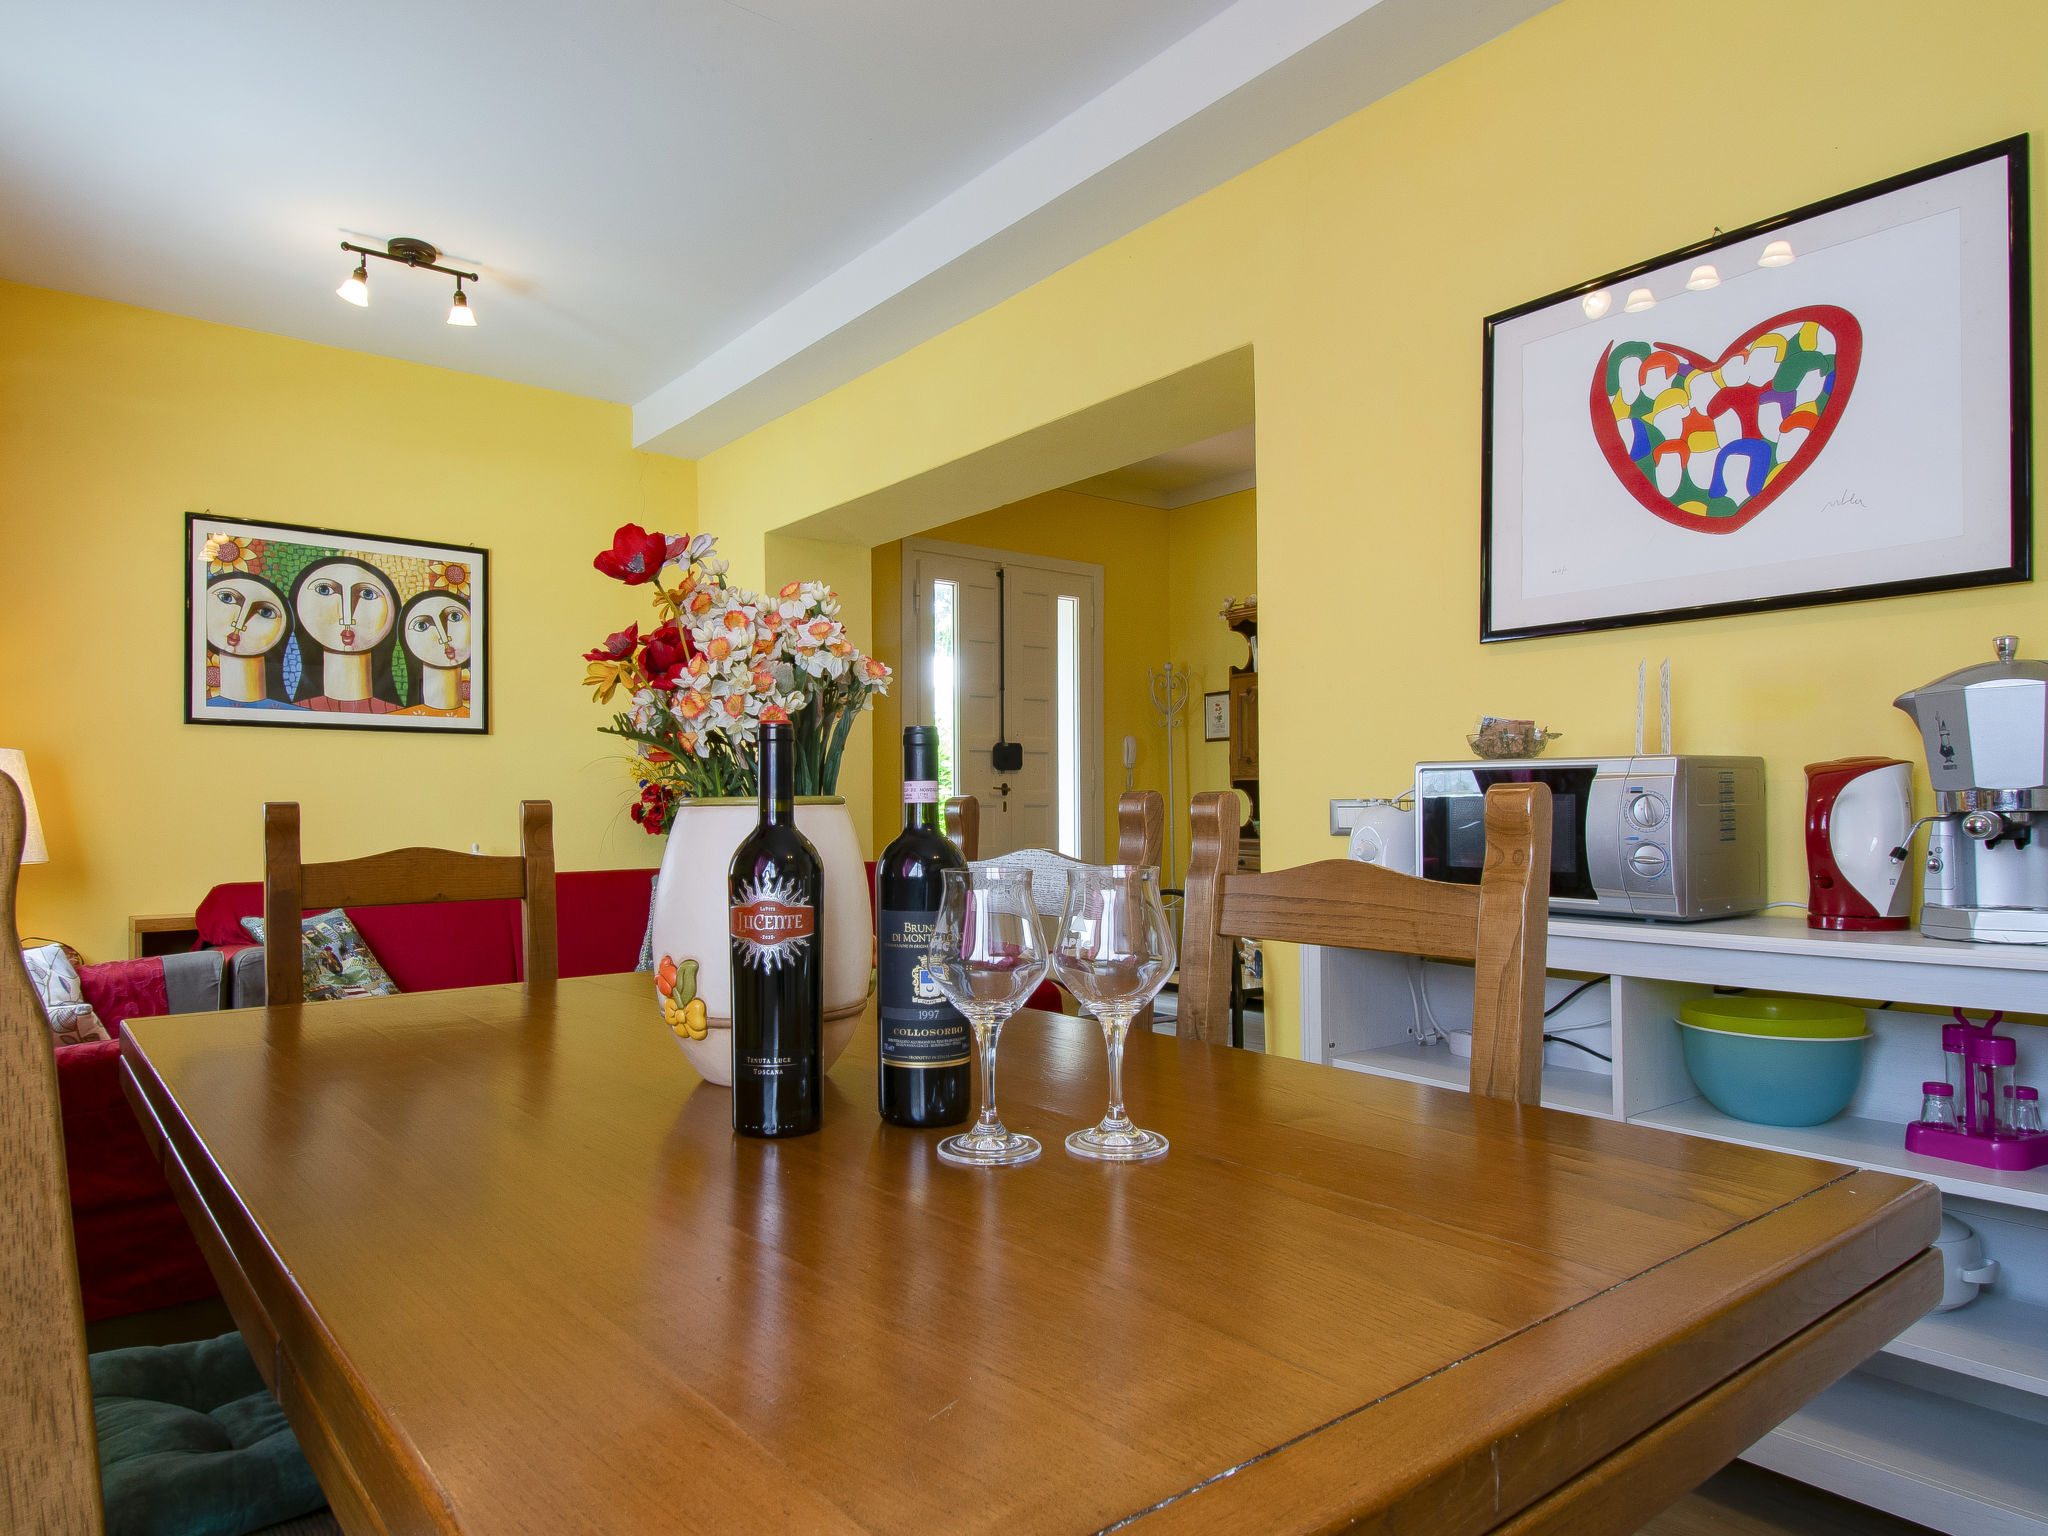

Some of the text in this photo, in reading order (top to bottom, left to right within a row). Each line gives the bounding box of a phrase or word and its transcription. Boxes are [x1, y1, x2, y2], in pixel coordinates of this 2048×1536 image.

[892, 933, 901, 942] DI
[919, 1010, 940, 1020] 1997
[893, 1026, 963, 1037] COLLOSORBO
[746, 1056, 771, 1064] TENUTA
